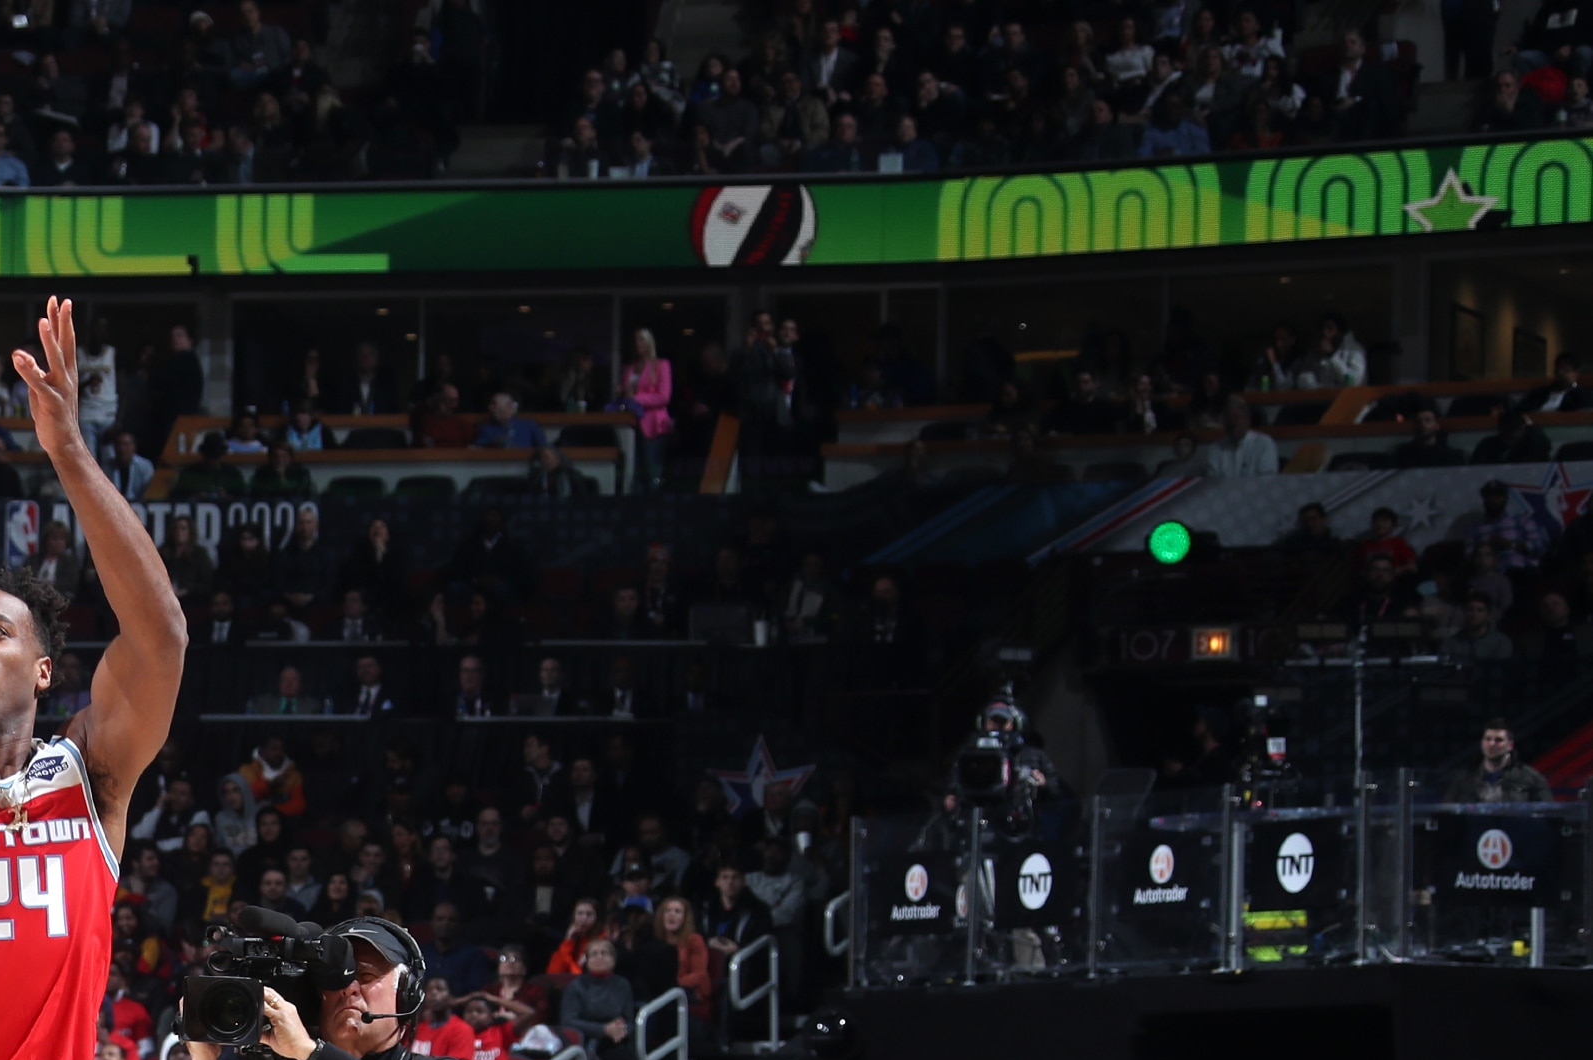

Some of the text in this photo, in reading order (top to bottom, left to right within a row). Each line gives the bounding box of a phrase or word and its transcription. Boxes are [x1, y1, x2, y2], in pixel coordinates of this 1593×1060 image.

[1455, 871, 1535, 891] Autotrader
[1133, 884, 1188, 905] Autotrader
[891, 903, 941, 921] Autotrader
